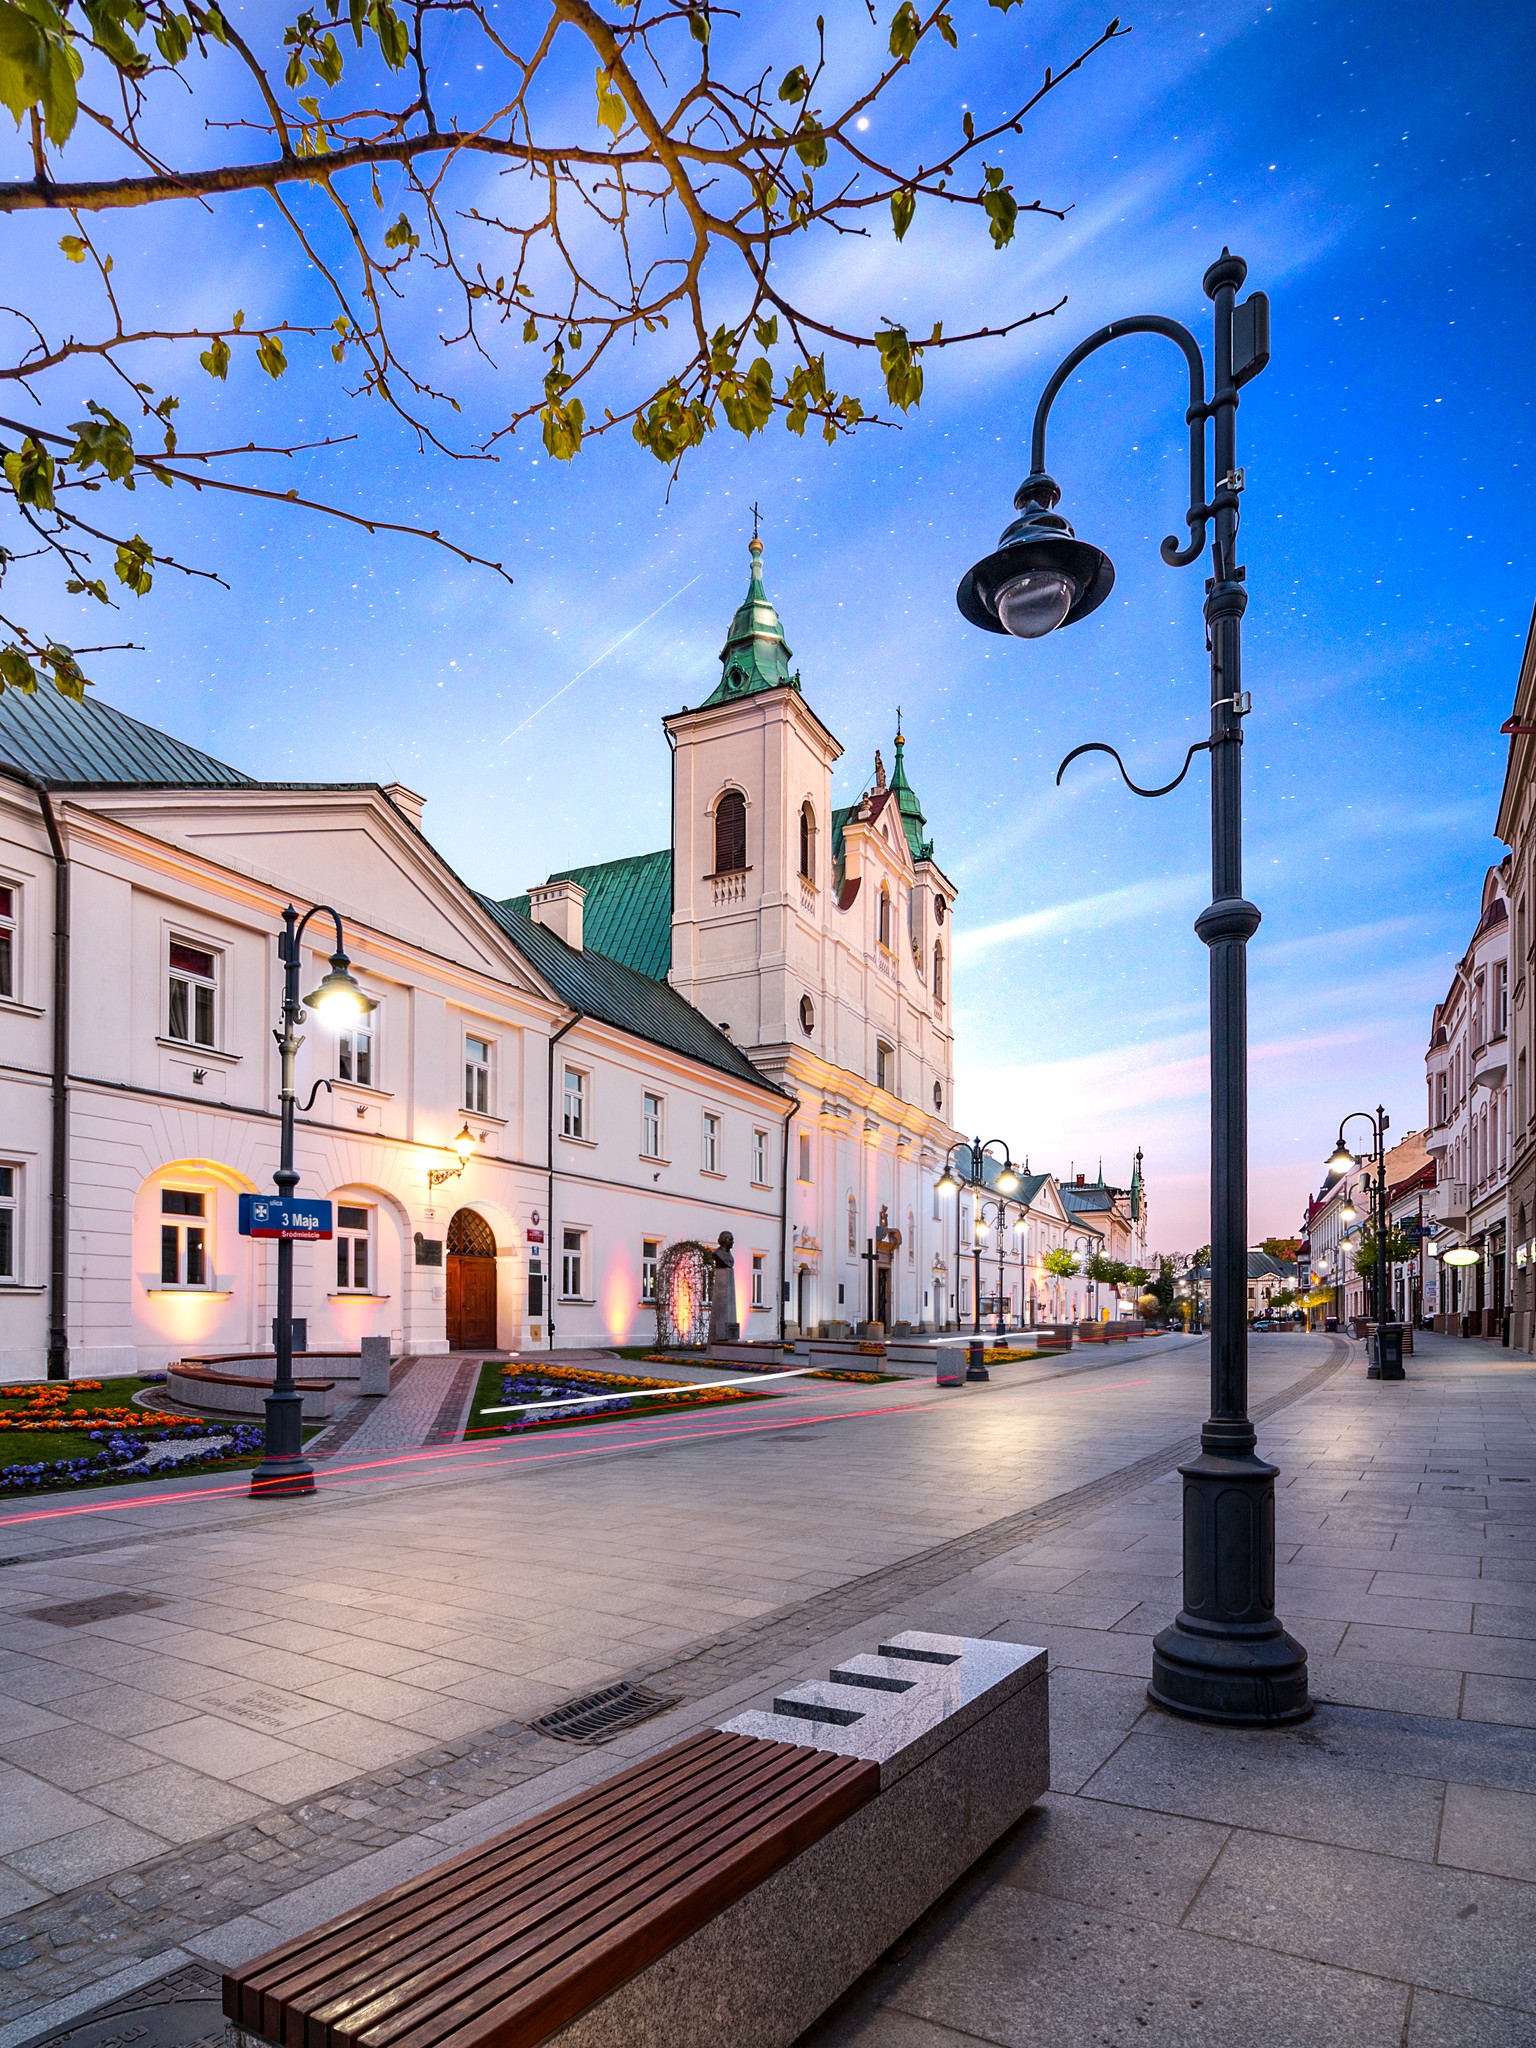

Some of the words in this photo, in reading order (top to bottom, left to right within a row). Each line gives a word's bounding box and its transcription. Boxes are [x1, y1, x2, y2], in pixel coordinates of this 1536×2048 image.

[282, 1213, 289, 1226] 3
[292, 1213, 319, 1230] Maja
[281, 1230, 320, 1238] Śródmieście
